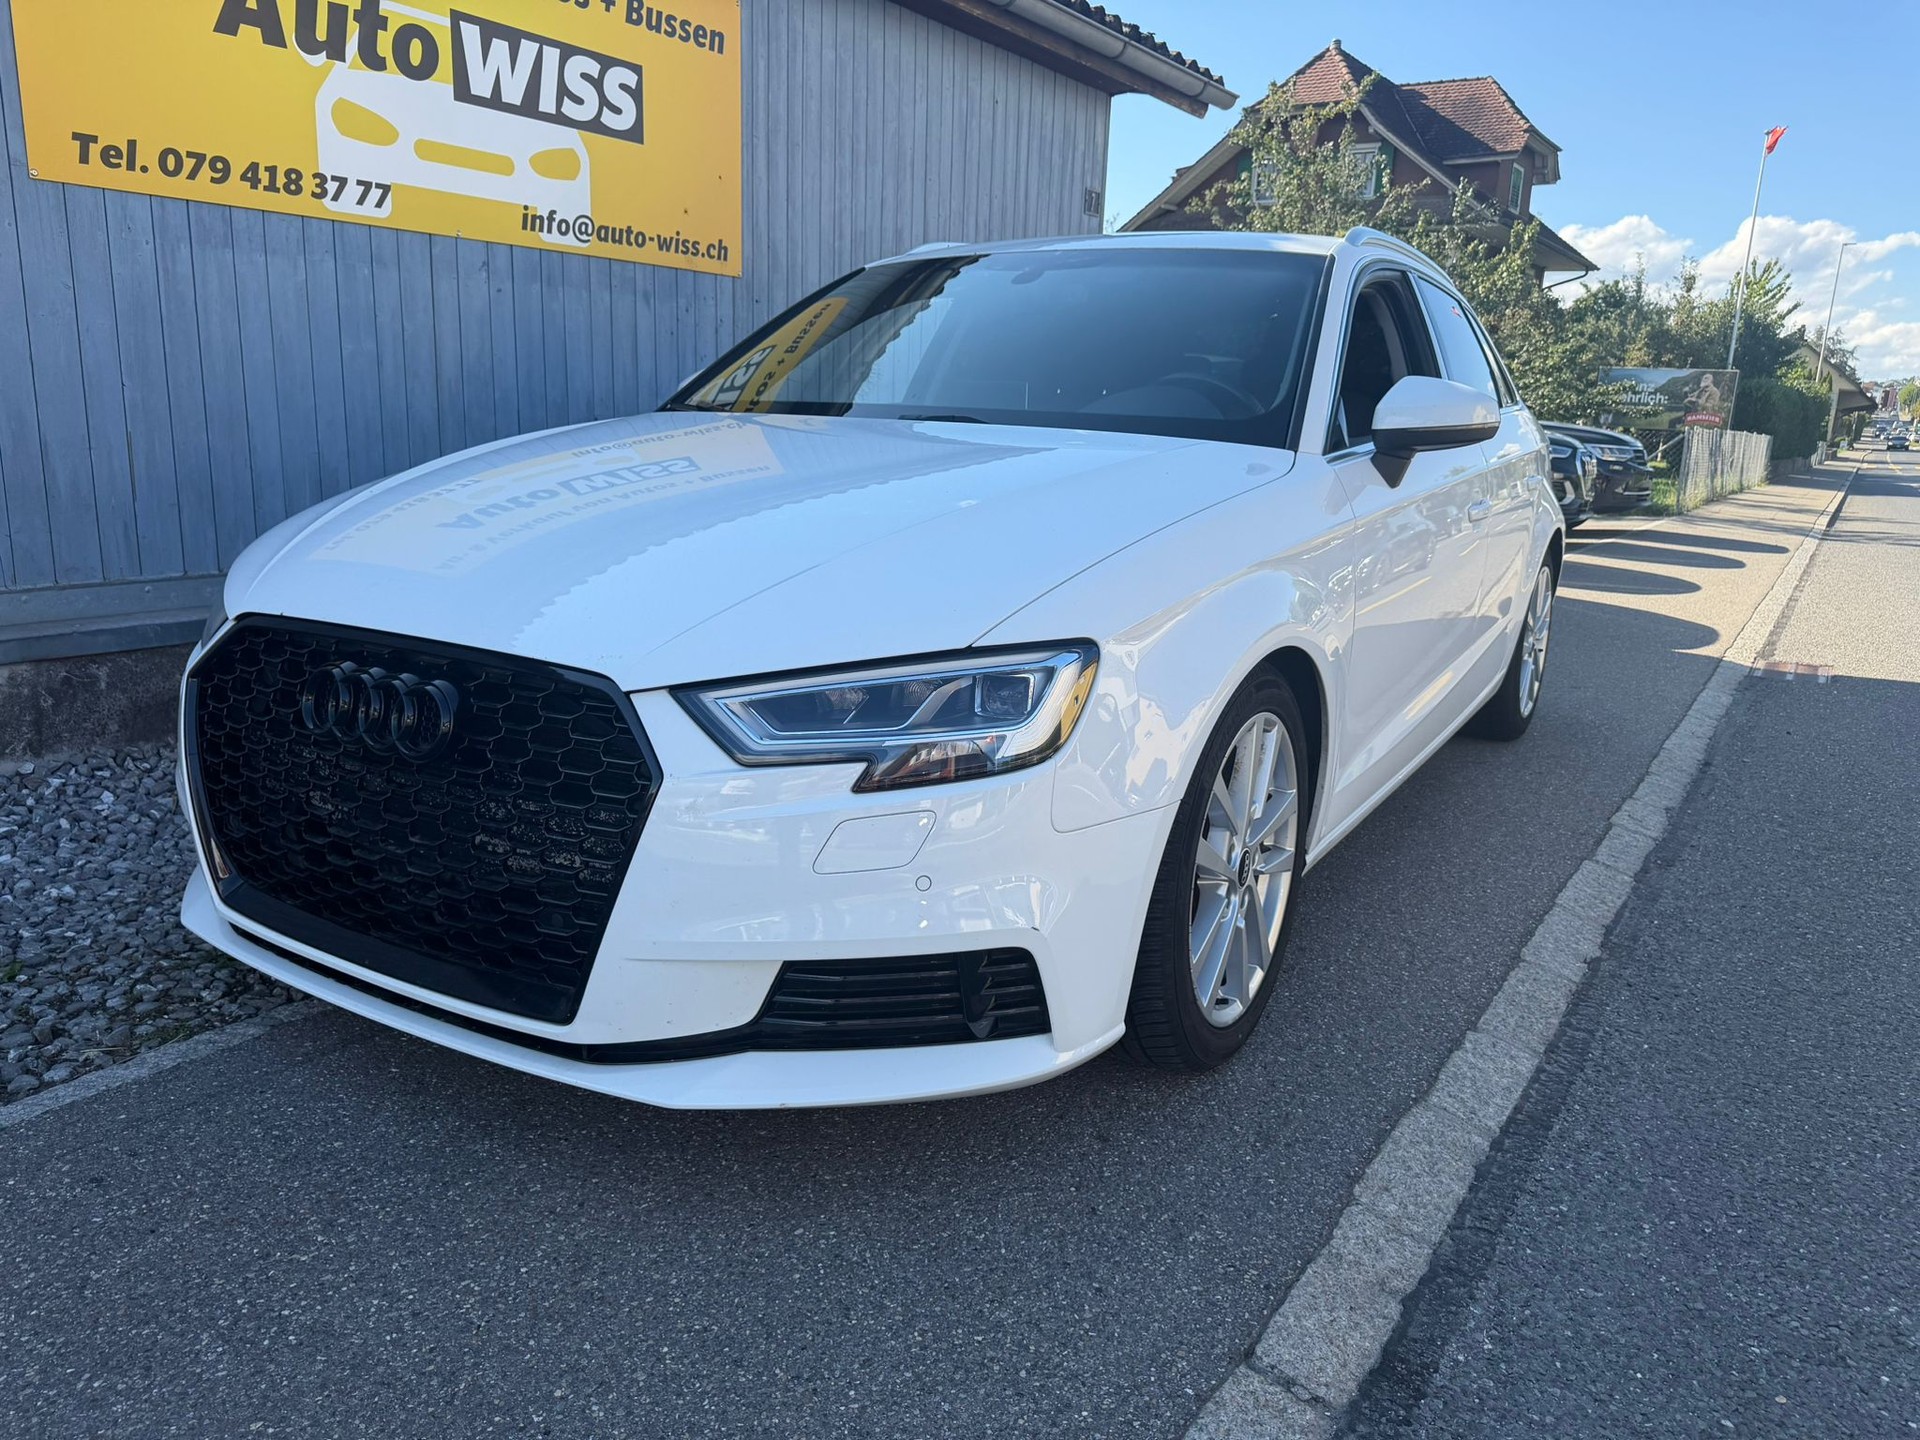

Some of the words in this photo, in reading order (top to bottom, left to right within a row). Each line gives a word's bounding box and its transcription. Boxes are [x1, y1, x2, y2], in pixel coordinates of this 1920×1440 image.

[625, 0, 726, 54] Bussen
[213, 0, 439, 81] Auto
[459, 20, 639, 131] WISS
[71, 132, 149, 173] Tel.
[158, 147, 231, 184] 079
[240, 161, 303, 196] 418
[311, 172, 348, 202] 37
[355, 179, 392, 208] 77
[521, 205, 729, 262] info@auto-wiss.ch
